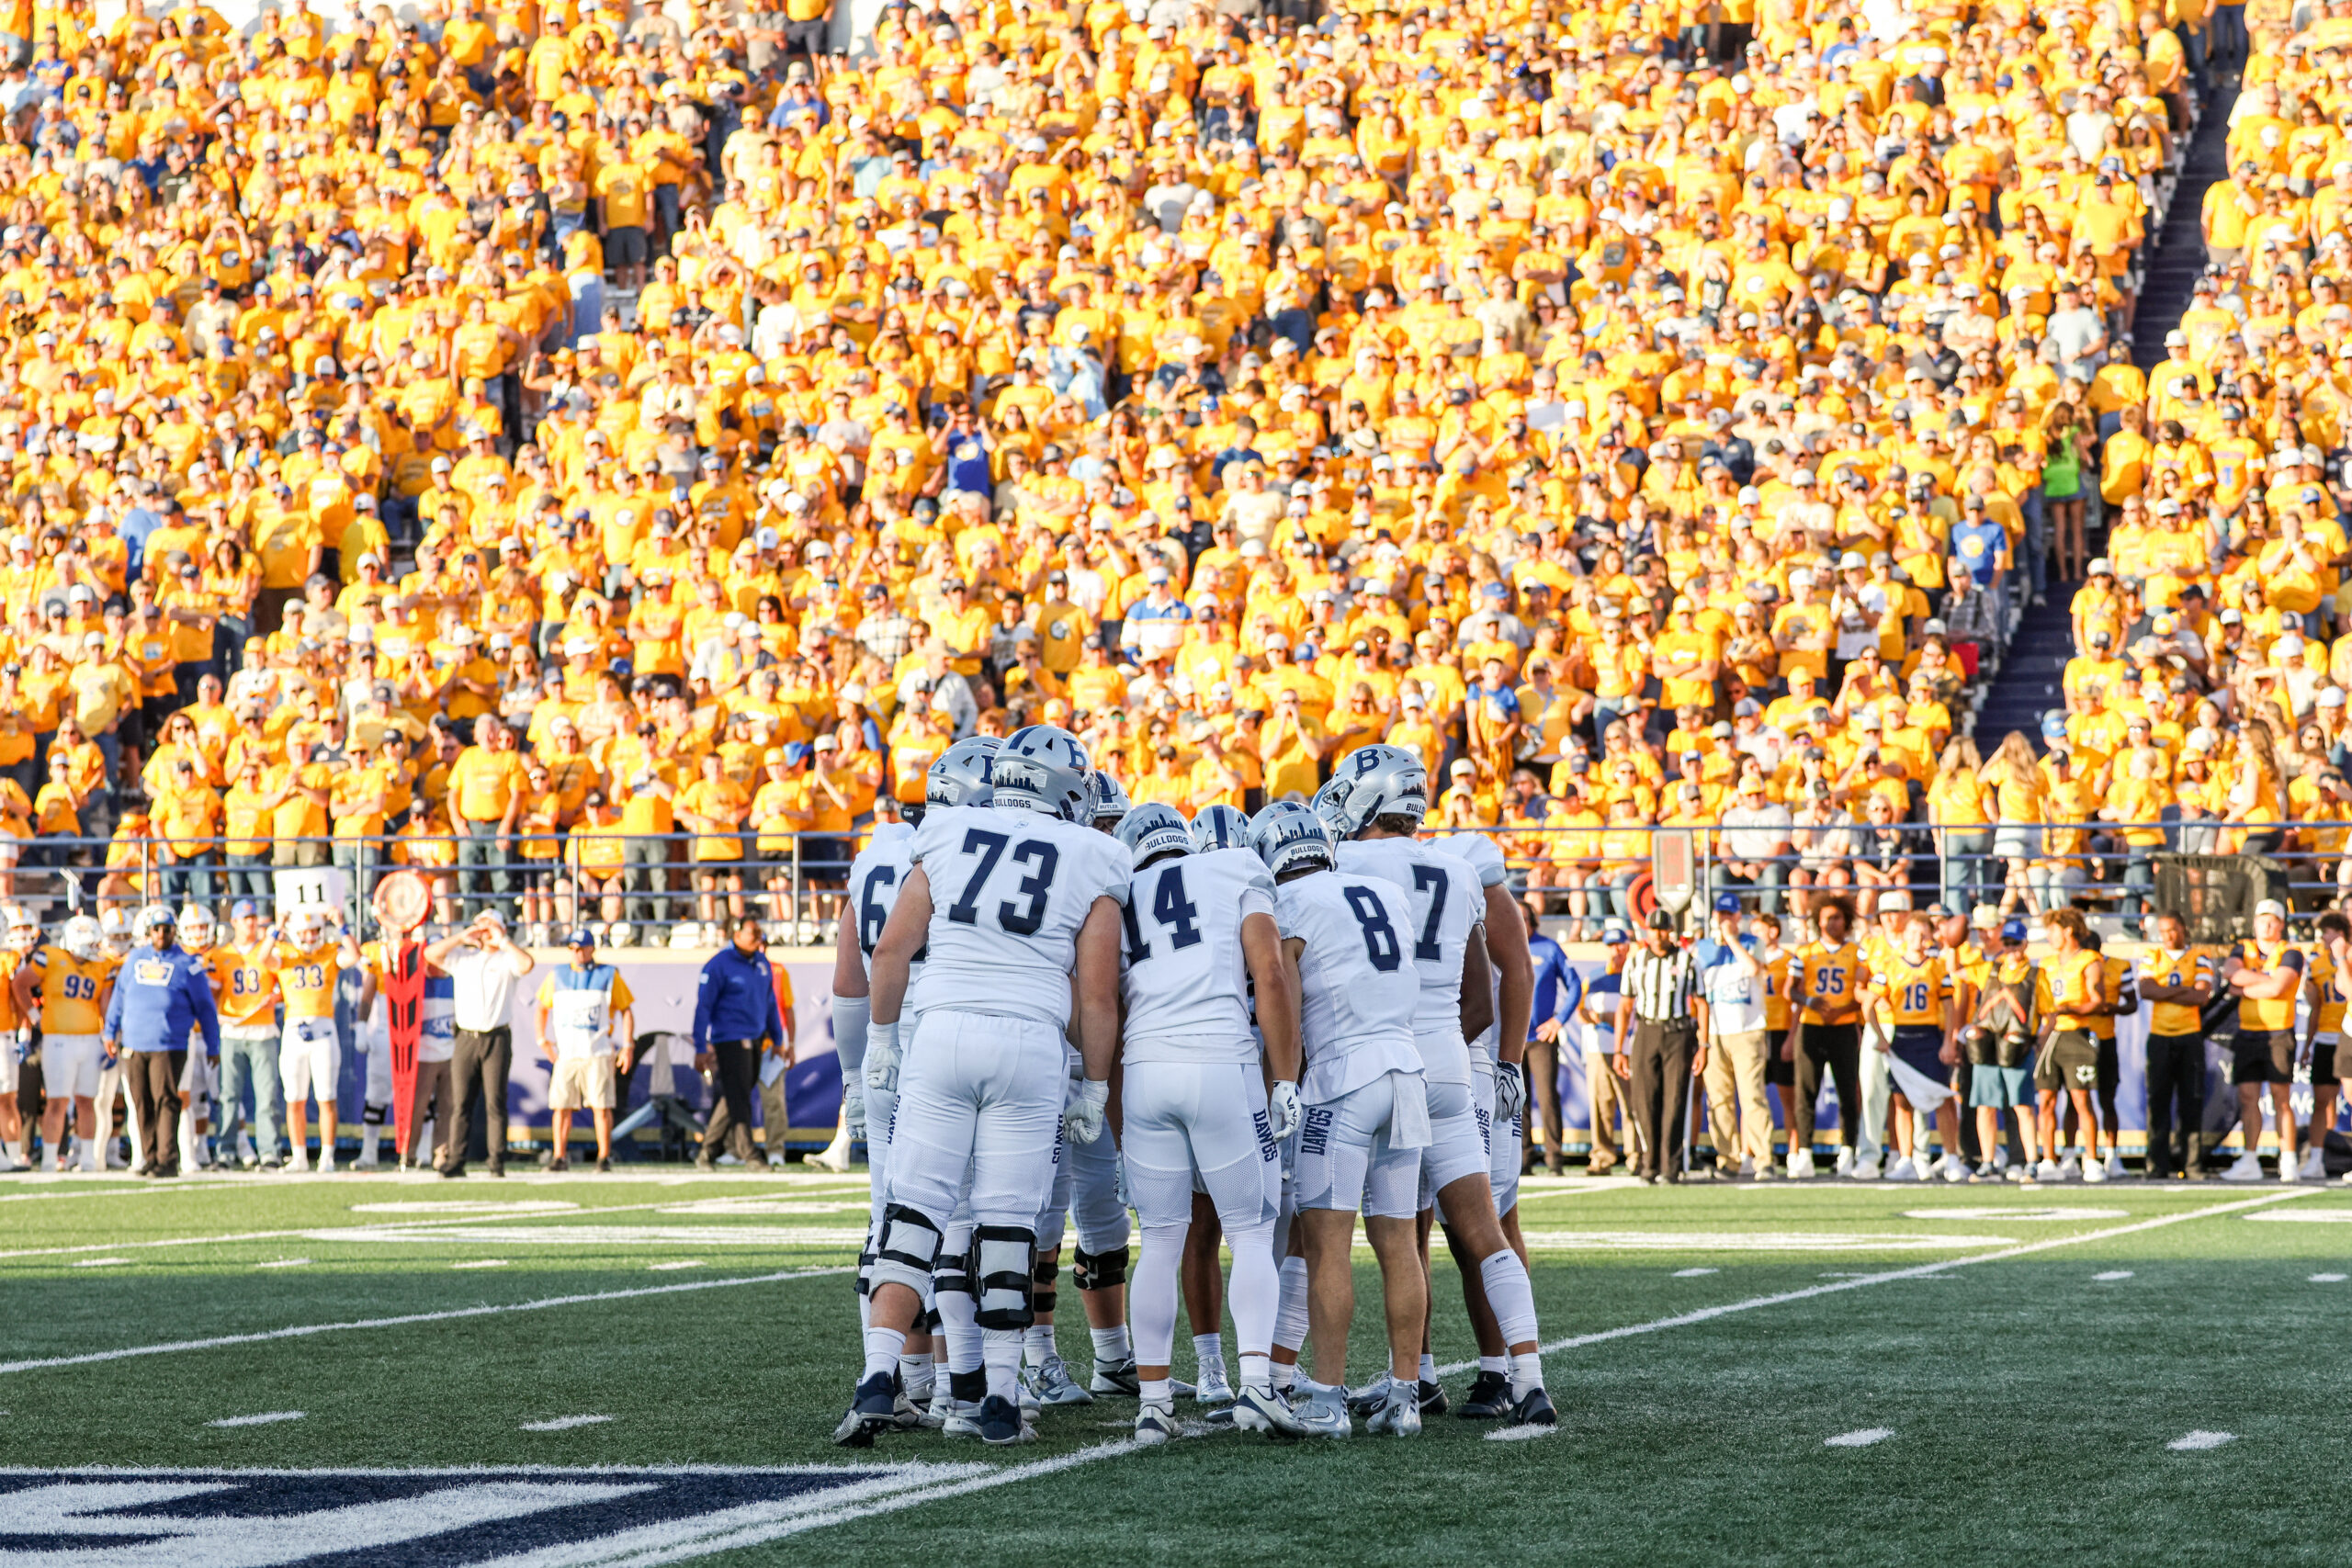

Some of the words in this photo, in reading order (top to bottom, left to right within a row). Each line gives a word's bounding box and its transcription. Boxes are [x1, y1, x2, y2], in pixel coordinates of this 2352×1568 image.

[1063, 738, 1087, 772] B
[1354, 748, 1380, 773] B
[1145, 834, 1189, 852] BULLDOGS
[1291, 845, 1324, 855] BULLDOGS
[297, 884, 325, 904] 11
[947, 827, 1061, 939] 73
[1120, 863, 1204, 968] 14
[1410, 863, 1451, 964] 7
[1342, 885, 1402, 974] 8
[63, 974, 96, 1001] 99
[232, 969, 260, 995] 93
[294, 964, 323, 988] 33
[1815, 967, 1846, 995] 95
[1903, 983, 1929, 1011] 16
[1252, 1108, 1279, 1163] DAWGS
[1300, 1107, 1334, 1156] DAWGS
[1511, 1111, 1522, 1138] DAW
[1385, 1403, 1401, 1425] NIKE
